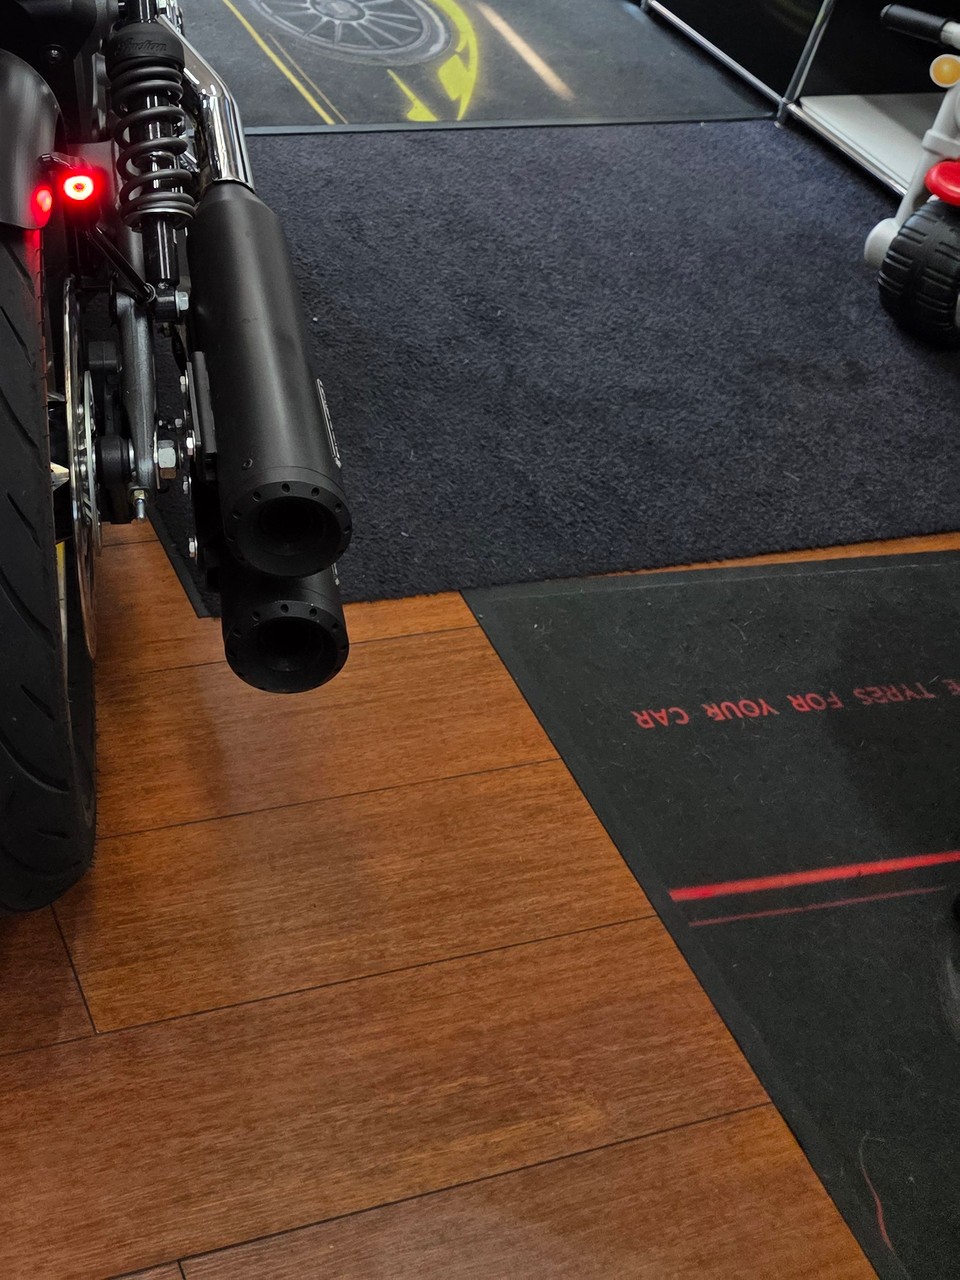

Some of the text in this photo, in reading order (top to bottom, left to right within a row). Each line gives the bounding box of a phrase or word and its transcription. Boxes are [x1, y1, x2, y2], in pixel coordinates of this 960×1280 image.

[787, 691, 844, 712] FOR
[852, 682, 936, 706] TYRES
[631, 706, 690, 729] CAR
[701, 698, 780, 721] YOUR
